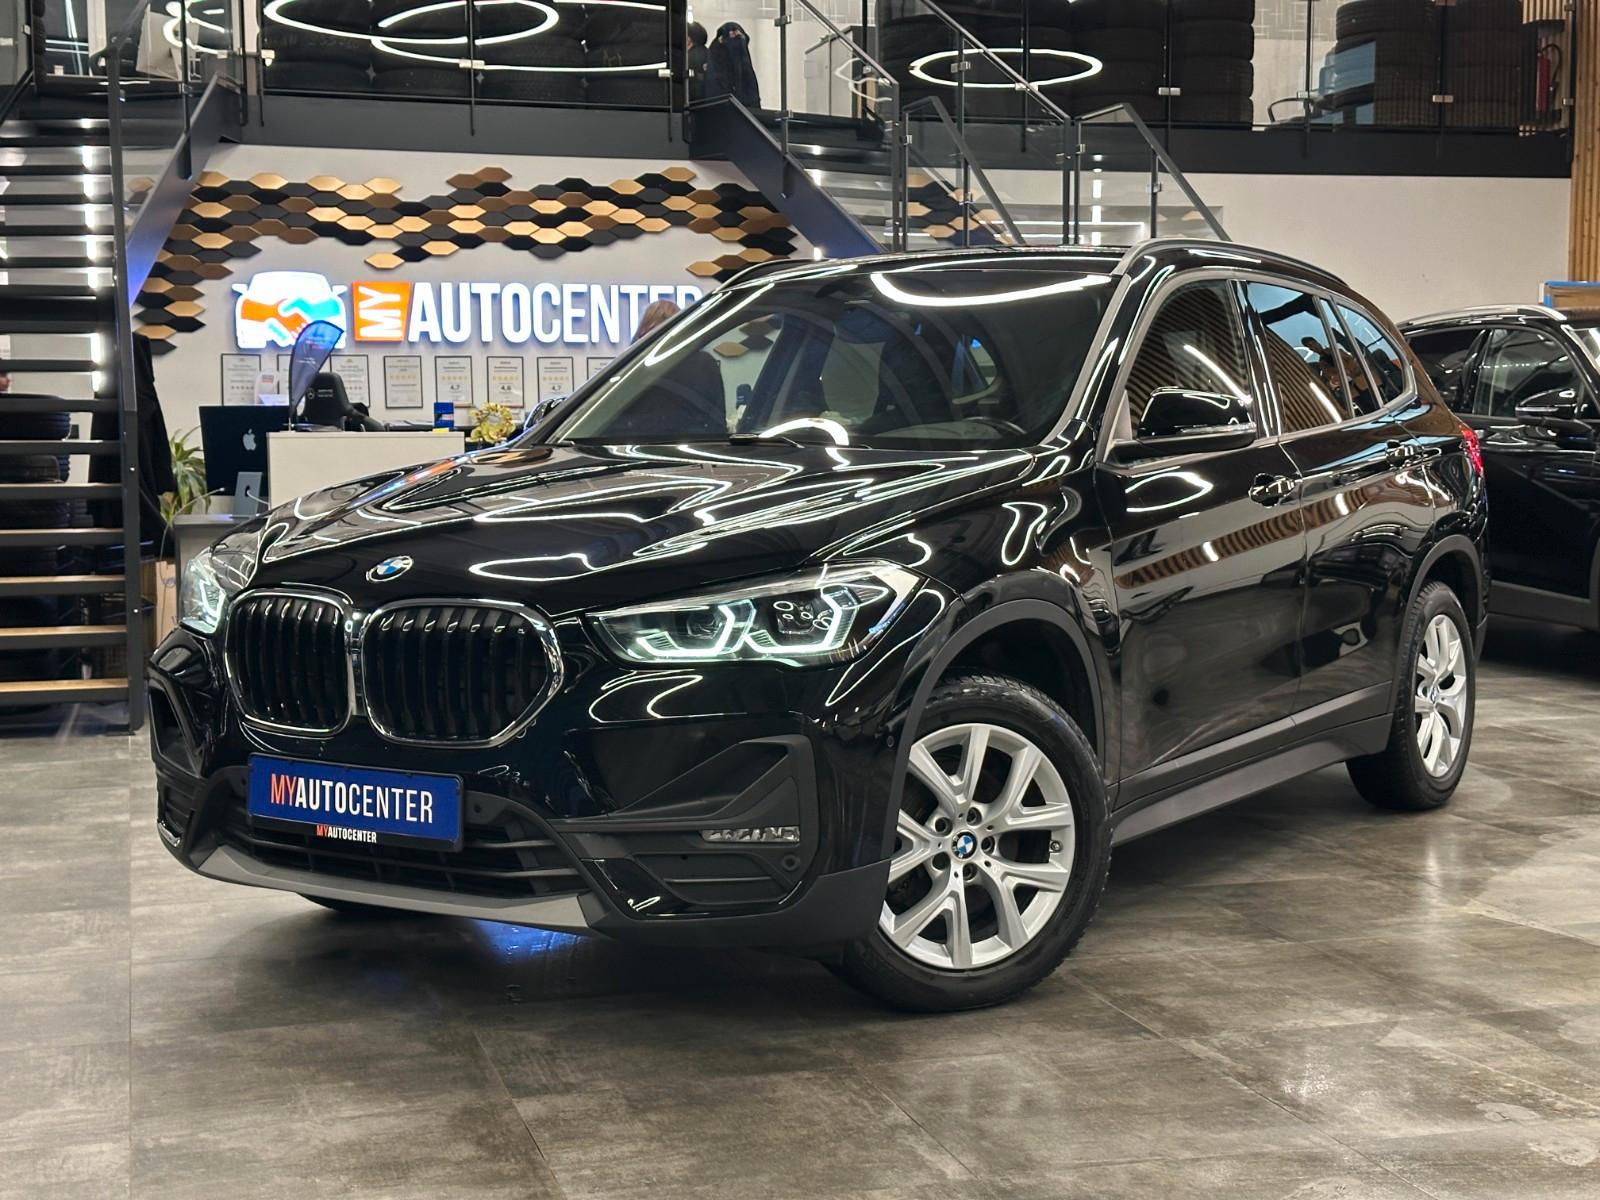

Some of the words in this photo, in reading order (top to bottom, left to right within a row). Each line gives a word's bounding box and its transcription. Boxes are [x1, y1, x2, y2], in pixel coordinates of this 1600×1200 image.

[359, 286, 402, 337] MY
[408, 282, 704, 343] AUTOCENT
[271, 773, 433, 824] MYAUTOCENTER
[316, 825, 377, 843] MYAUTOCENTER
